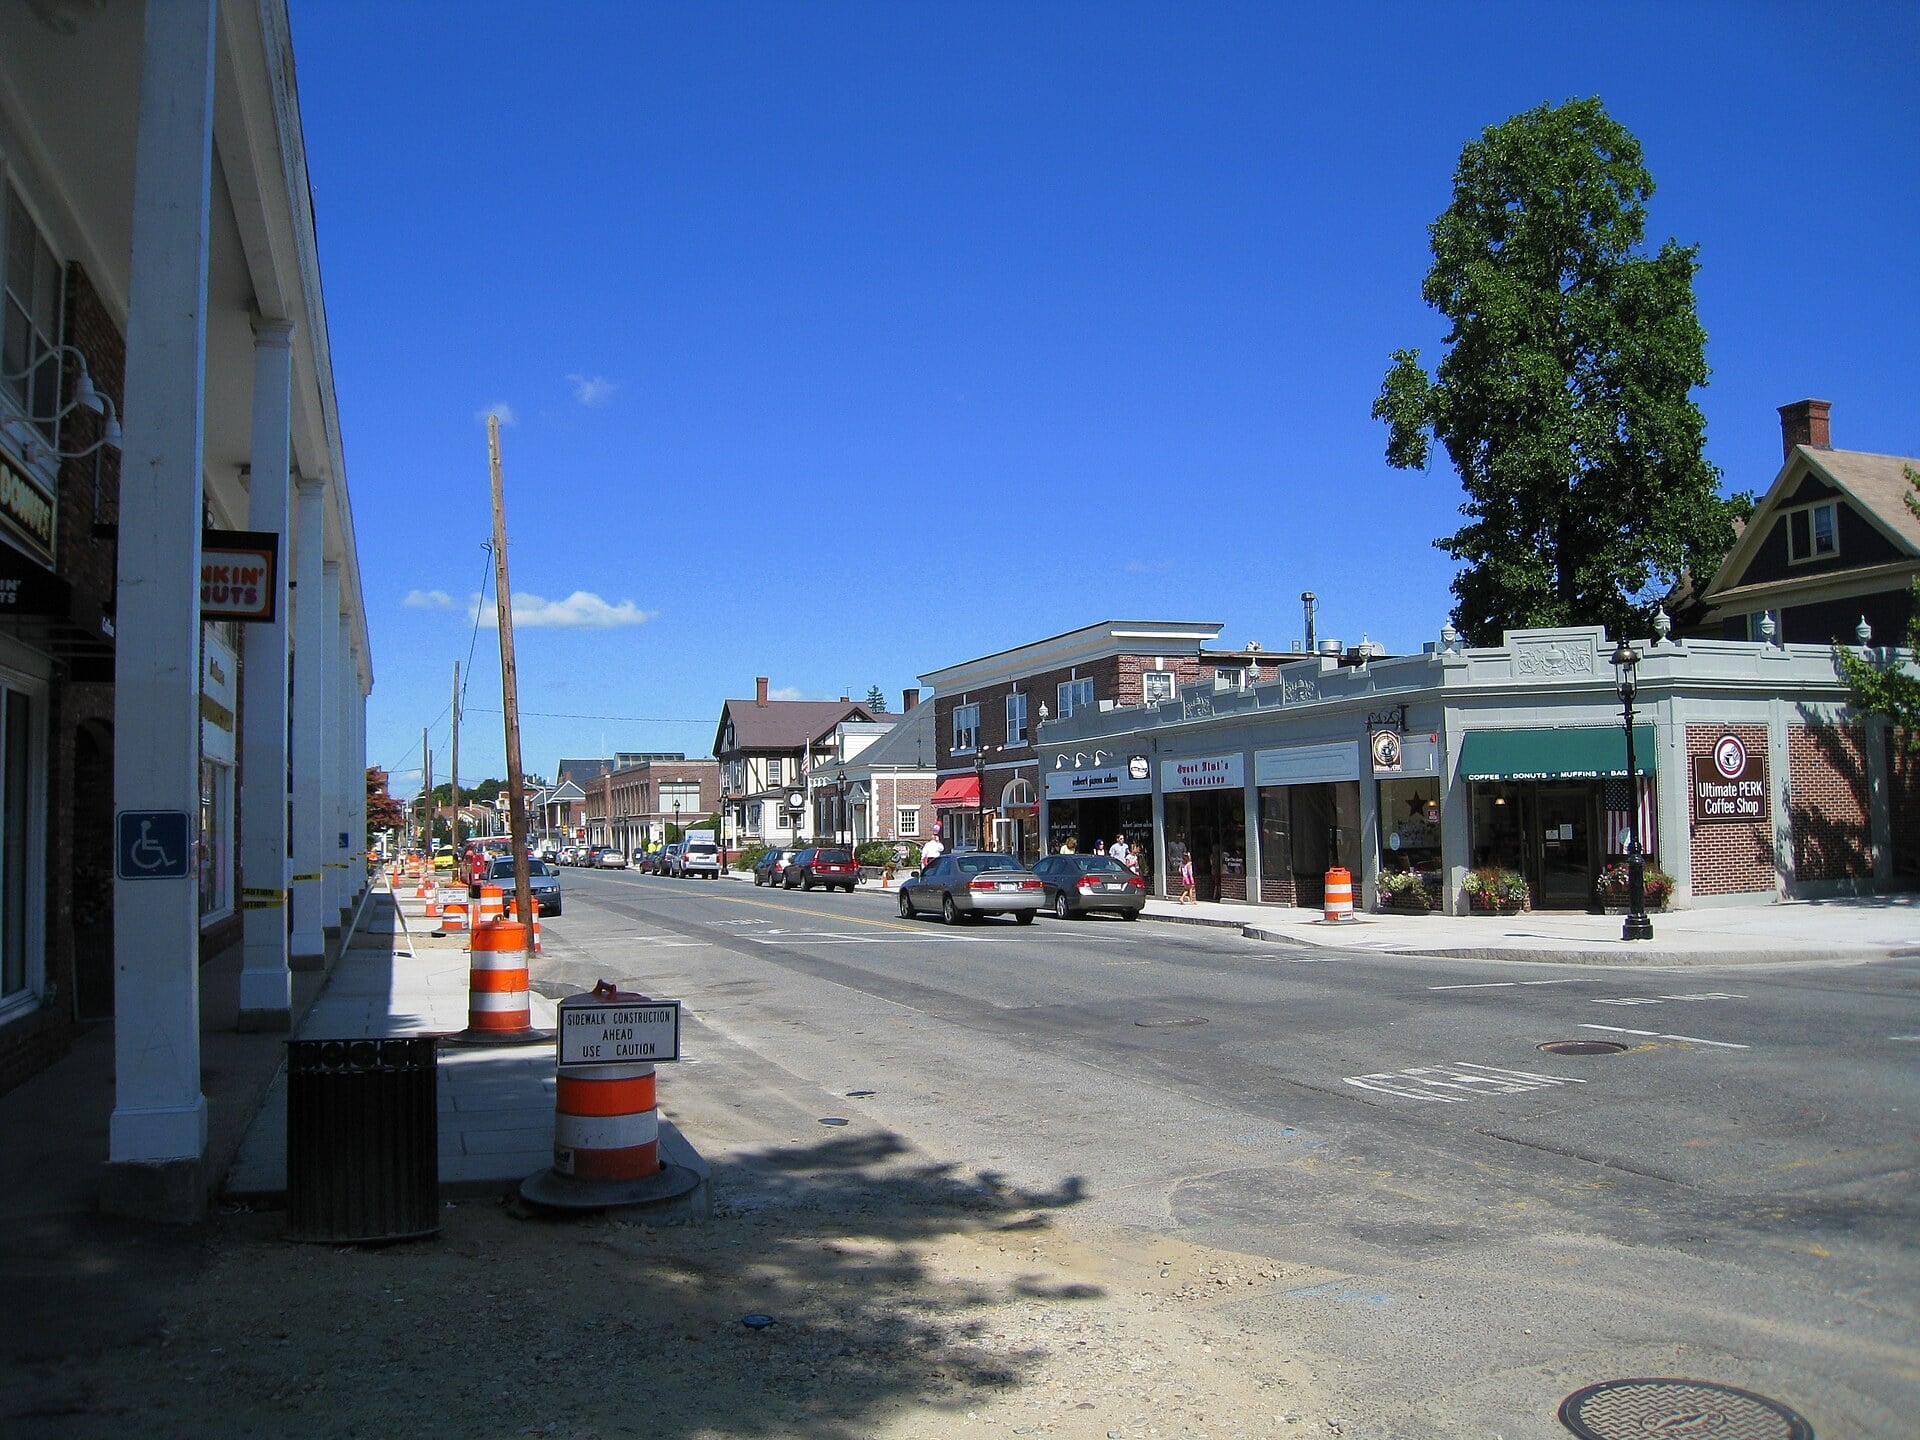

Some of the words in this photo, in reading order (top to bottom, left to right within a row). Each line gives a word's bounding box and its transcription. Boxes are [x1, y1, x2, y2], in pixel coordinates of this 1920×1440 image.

[1177, 764, 1198, 774] Sweet
[1468, 773, 1500, 781] COFFEE
[1512, 772, 1547, 780] DONUTS
[1560, 770, 1597, 778] MUFFINS
[1182, 776, 1225, 786] Chocolates
[1698, 781, 1738, 797] Ultimate
[1738, 781, 1763, 797] PERK
[1705, 798, 1735, 814] Coffee
[1736, 797, 1759, 816] Shop
[567, 1013, 606, 1026] SIDEWALK
[613, 1011, 670, 1025] CONSTRUCTION
[602, 1029, 633, 1041] AHEAD
[582, 1045, 601, 1058] USE
[616, 1043, 655, 1056] CAUTION
